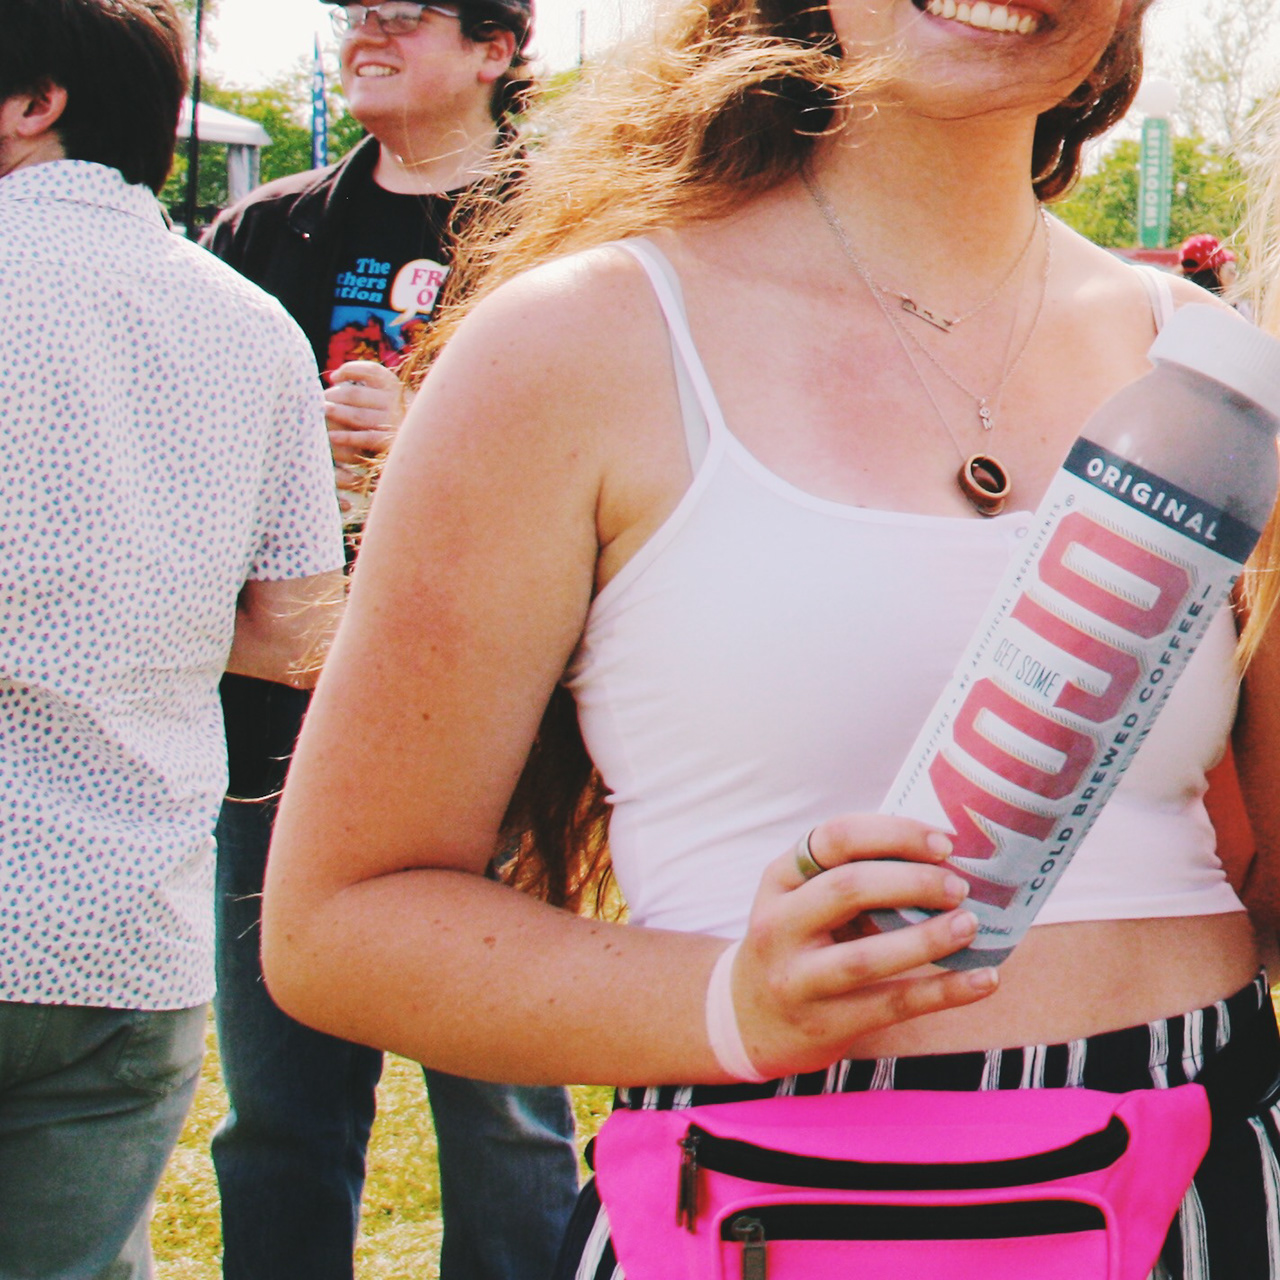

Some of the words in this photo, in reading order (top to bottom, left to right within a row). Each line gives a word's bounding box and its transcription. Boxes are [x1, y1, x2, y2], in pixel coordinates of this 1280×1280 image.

[356, 258, 392, 275] The
[1086, 456, 1218, 542] ORIGINAL
[971, 597, 1012, 668] ARTIFICIAL
[1012, 502, 1061, 590] INGREDIENTS
[928, 510, 1195, 911] MOJO
[993, 638, 1021, 670] GET
[1015, 654, 1061, 698] SOME
[1029, 826, 1075, 894] COLD
[1071, 712, 1140, 817] BREWED
[1138, 599, 1204, 703] COFFEE
